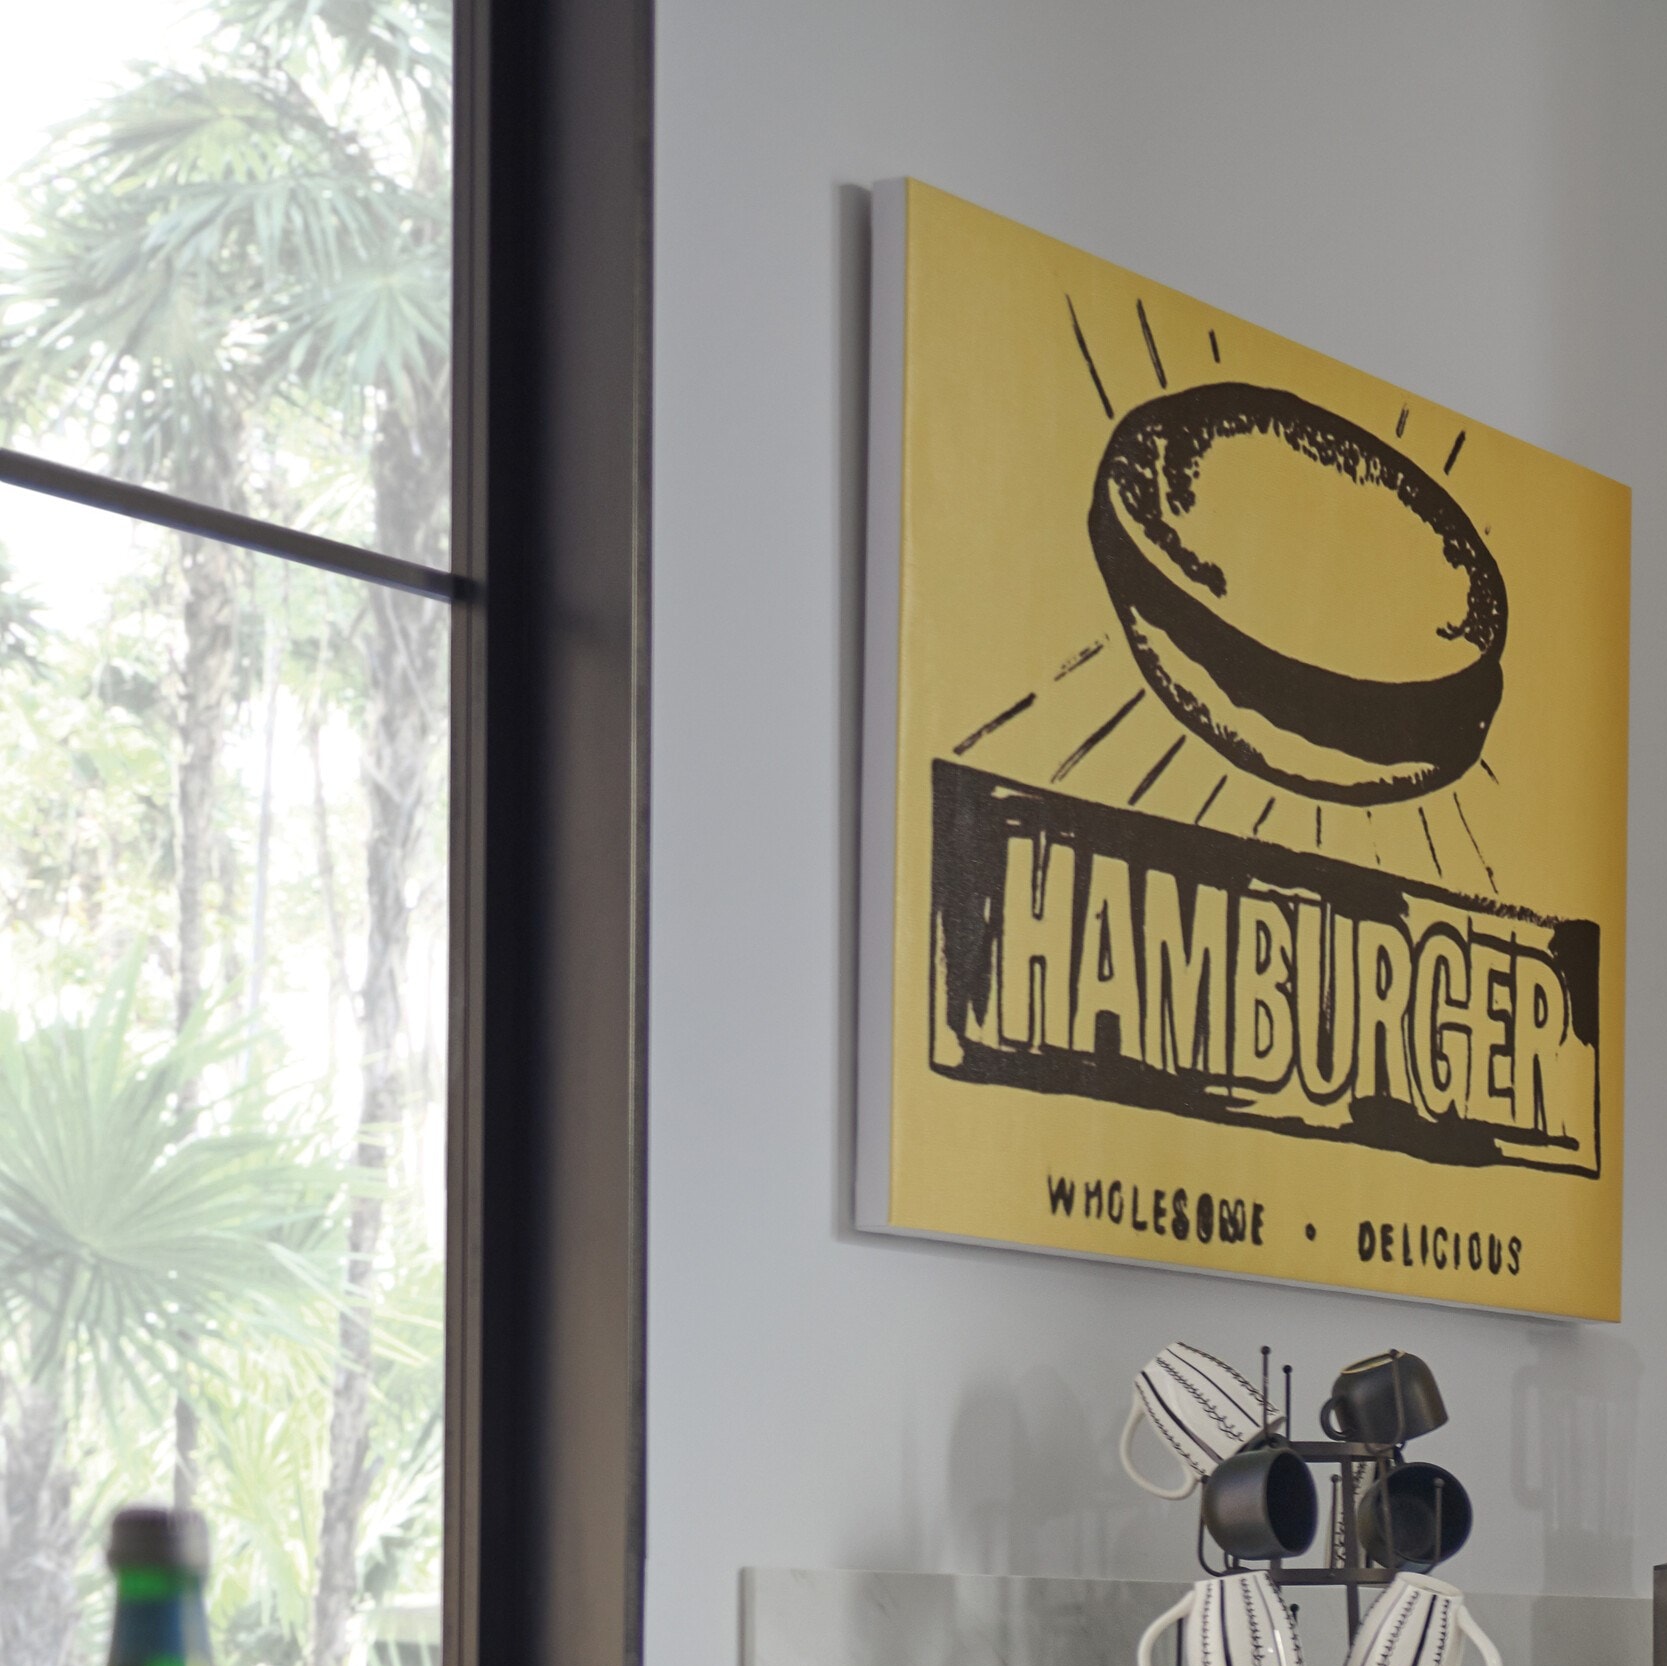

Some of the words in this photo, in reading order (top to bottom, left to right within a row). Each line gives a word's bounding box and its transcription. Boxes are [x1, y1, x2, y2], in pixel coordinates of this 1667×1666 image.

[1002, 836, 1570, 1140] HAMBURGER
[1047, 1174, 1265, 1246] WHOLESOME
[1358, 1220, 1523, 1276] DELICIOUS
